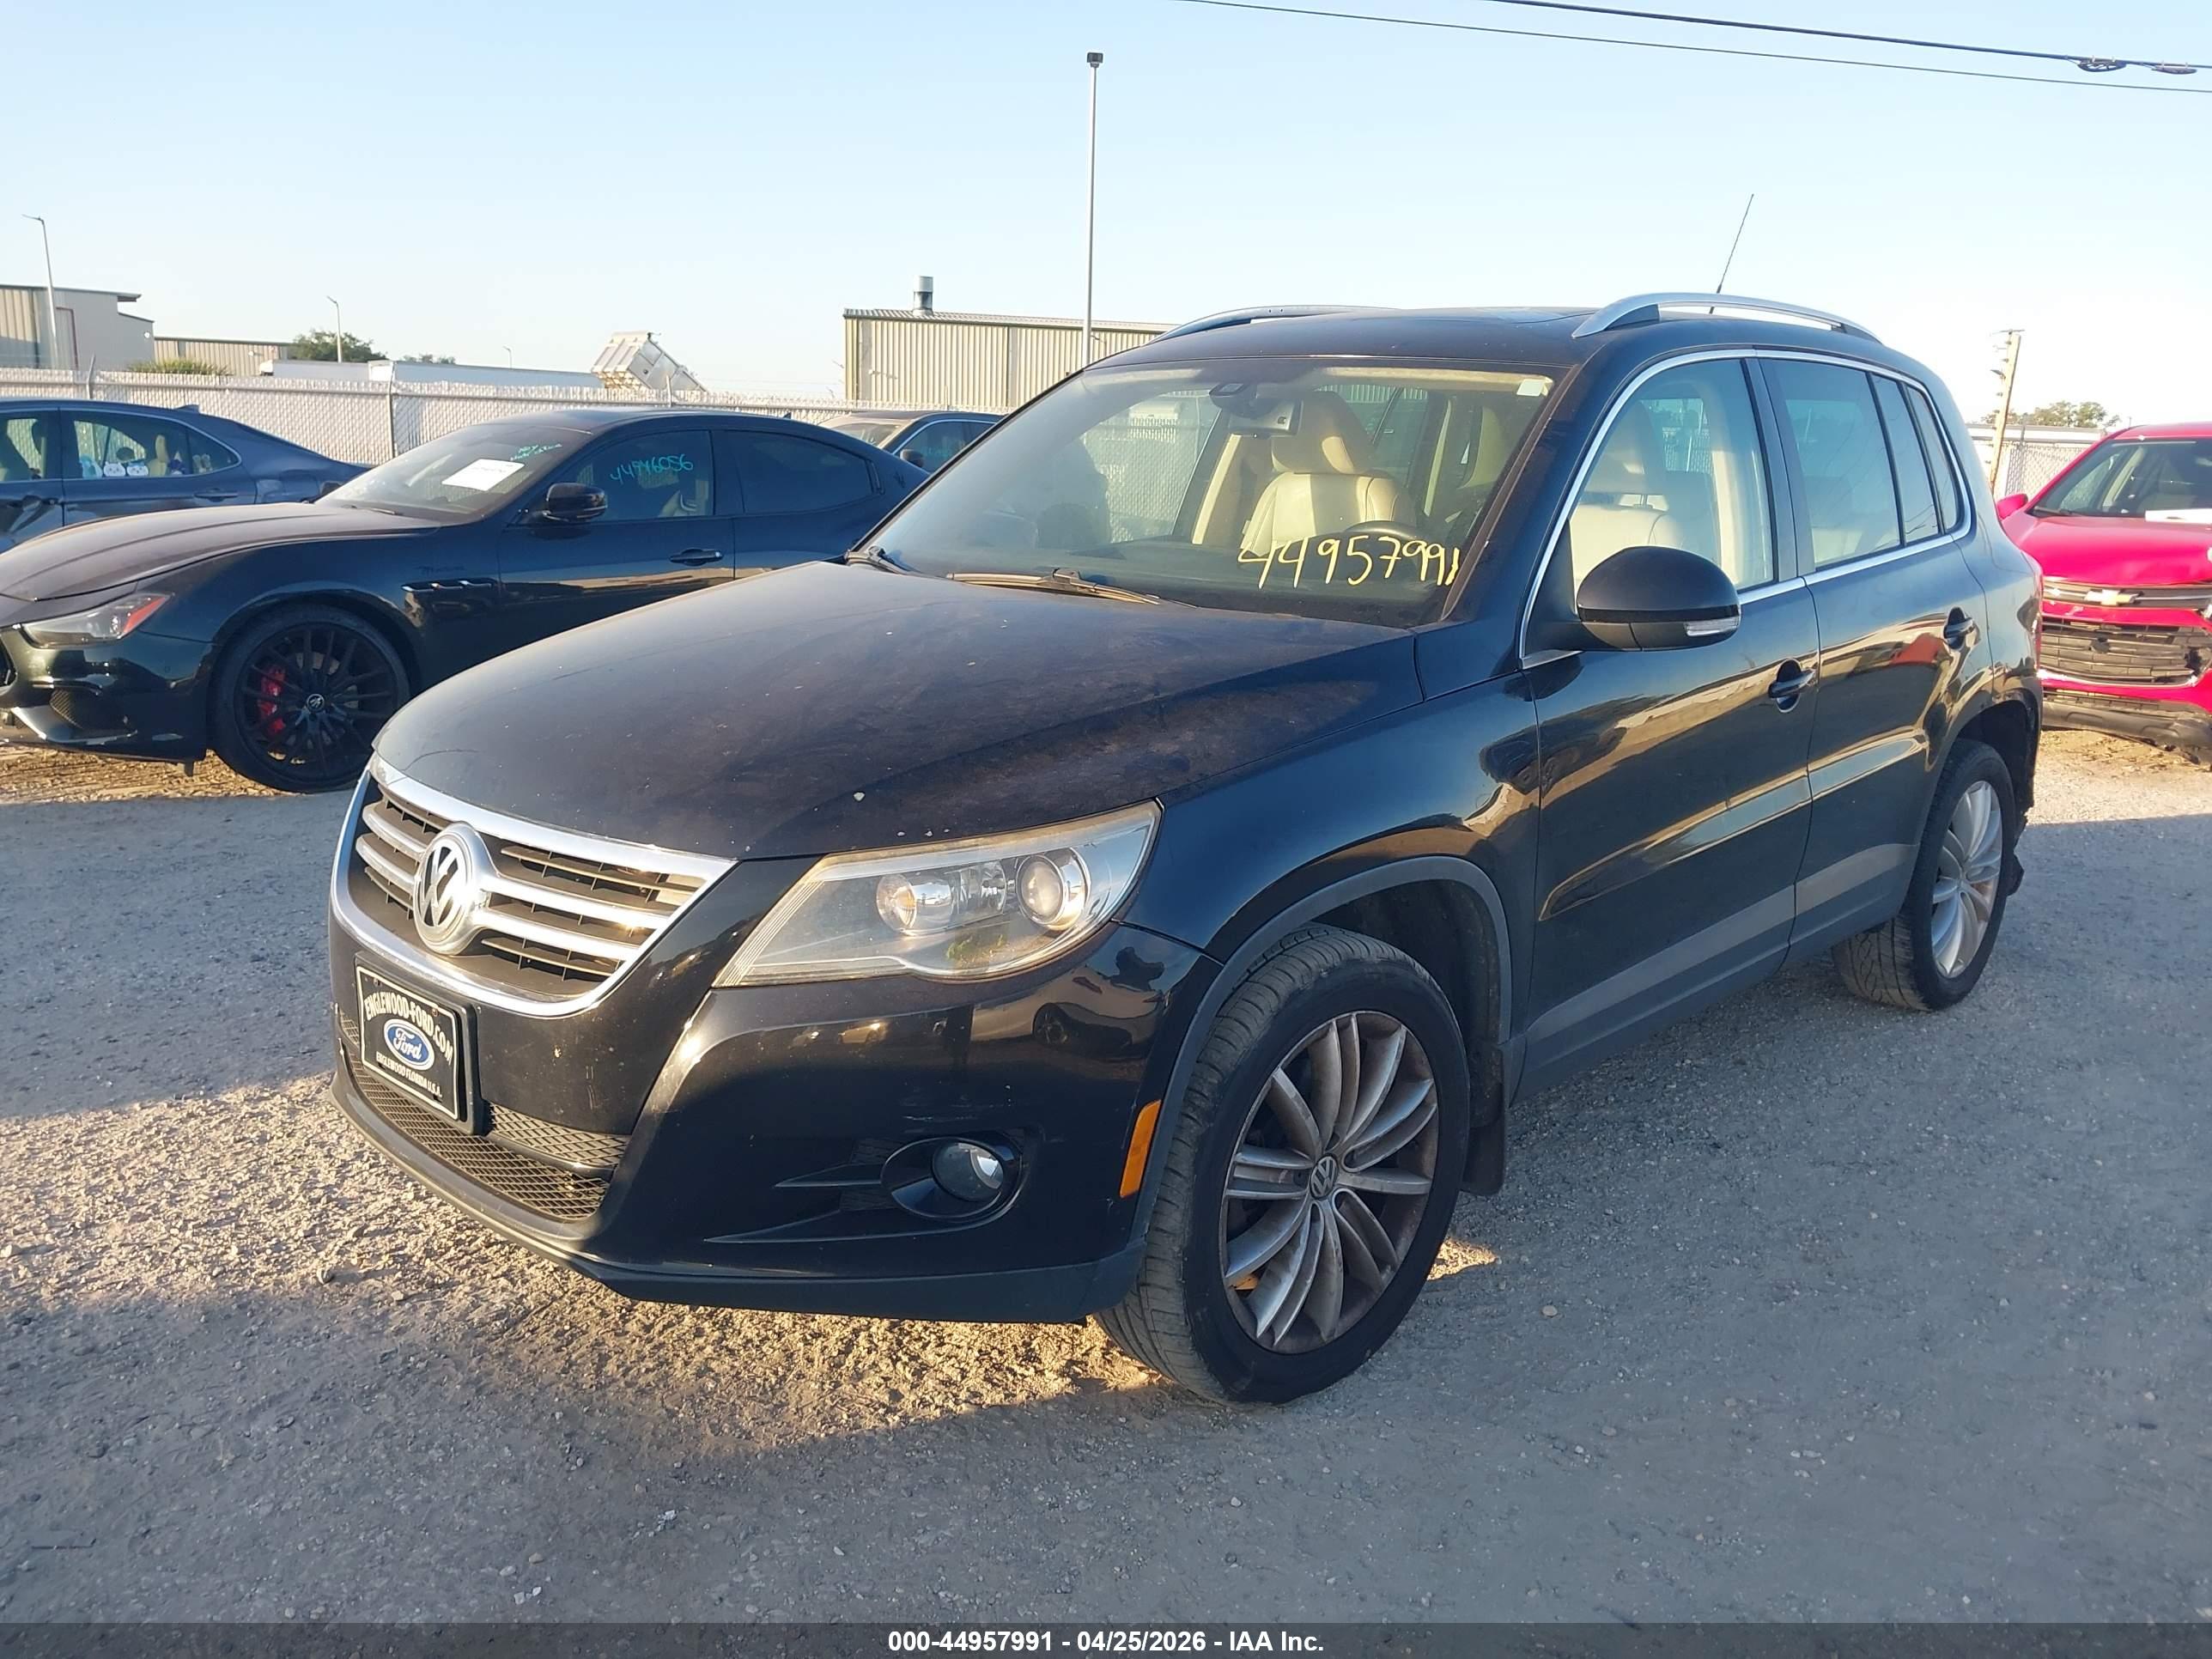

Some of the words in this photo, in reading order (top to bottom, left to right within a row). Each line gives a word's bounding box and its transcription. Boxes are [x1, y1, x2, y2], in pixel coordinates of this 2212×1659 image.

[1237, 535, 1460, 589] 44957991
[392, 1027, 422, 1060] Ford
[375, 1050, 406, 1077] ENGLEWOOD
[405, 1067, 428, 1090] FLORIDA
